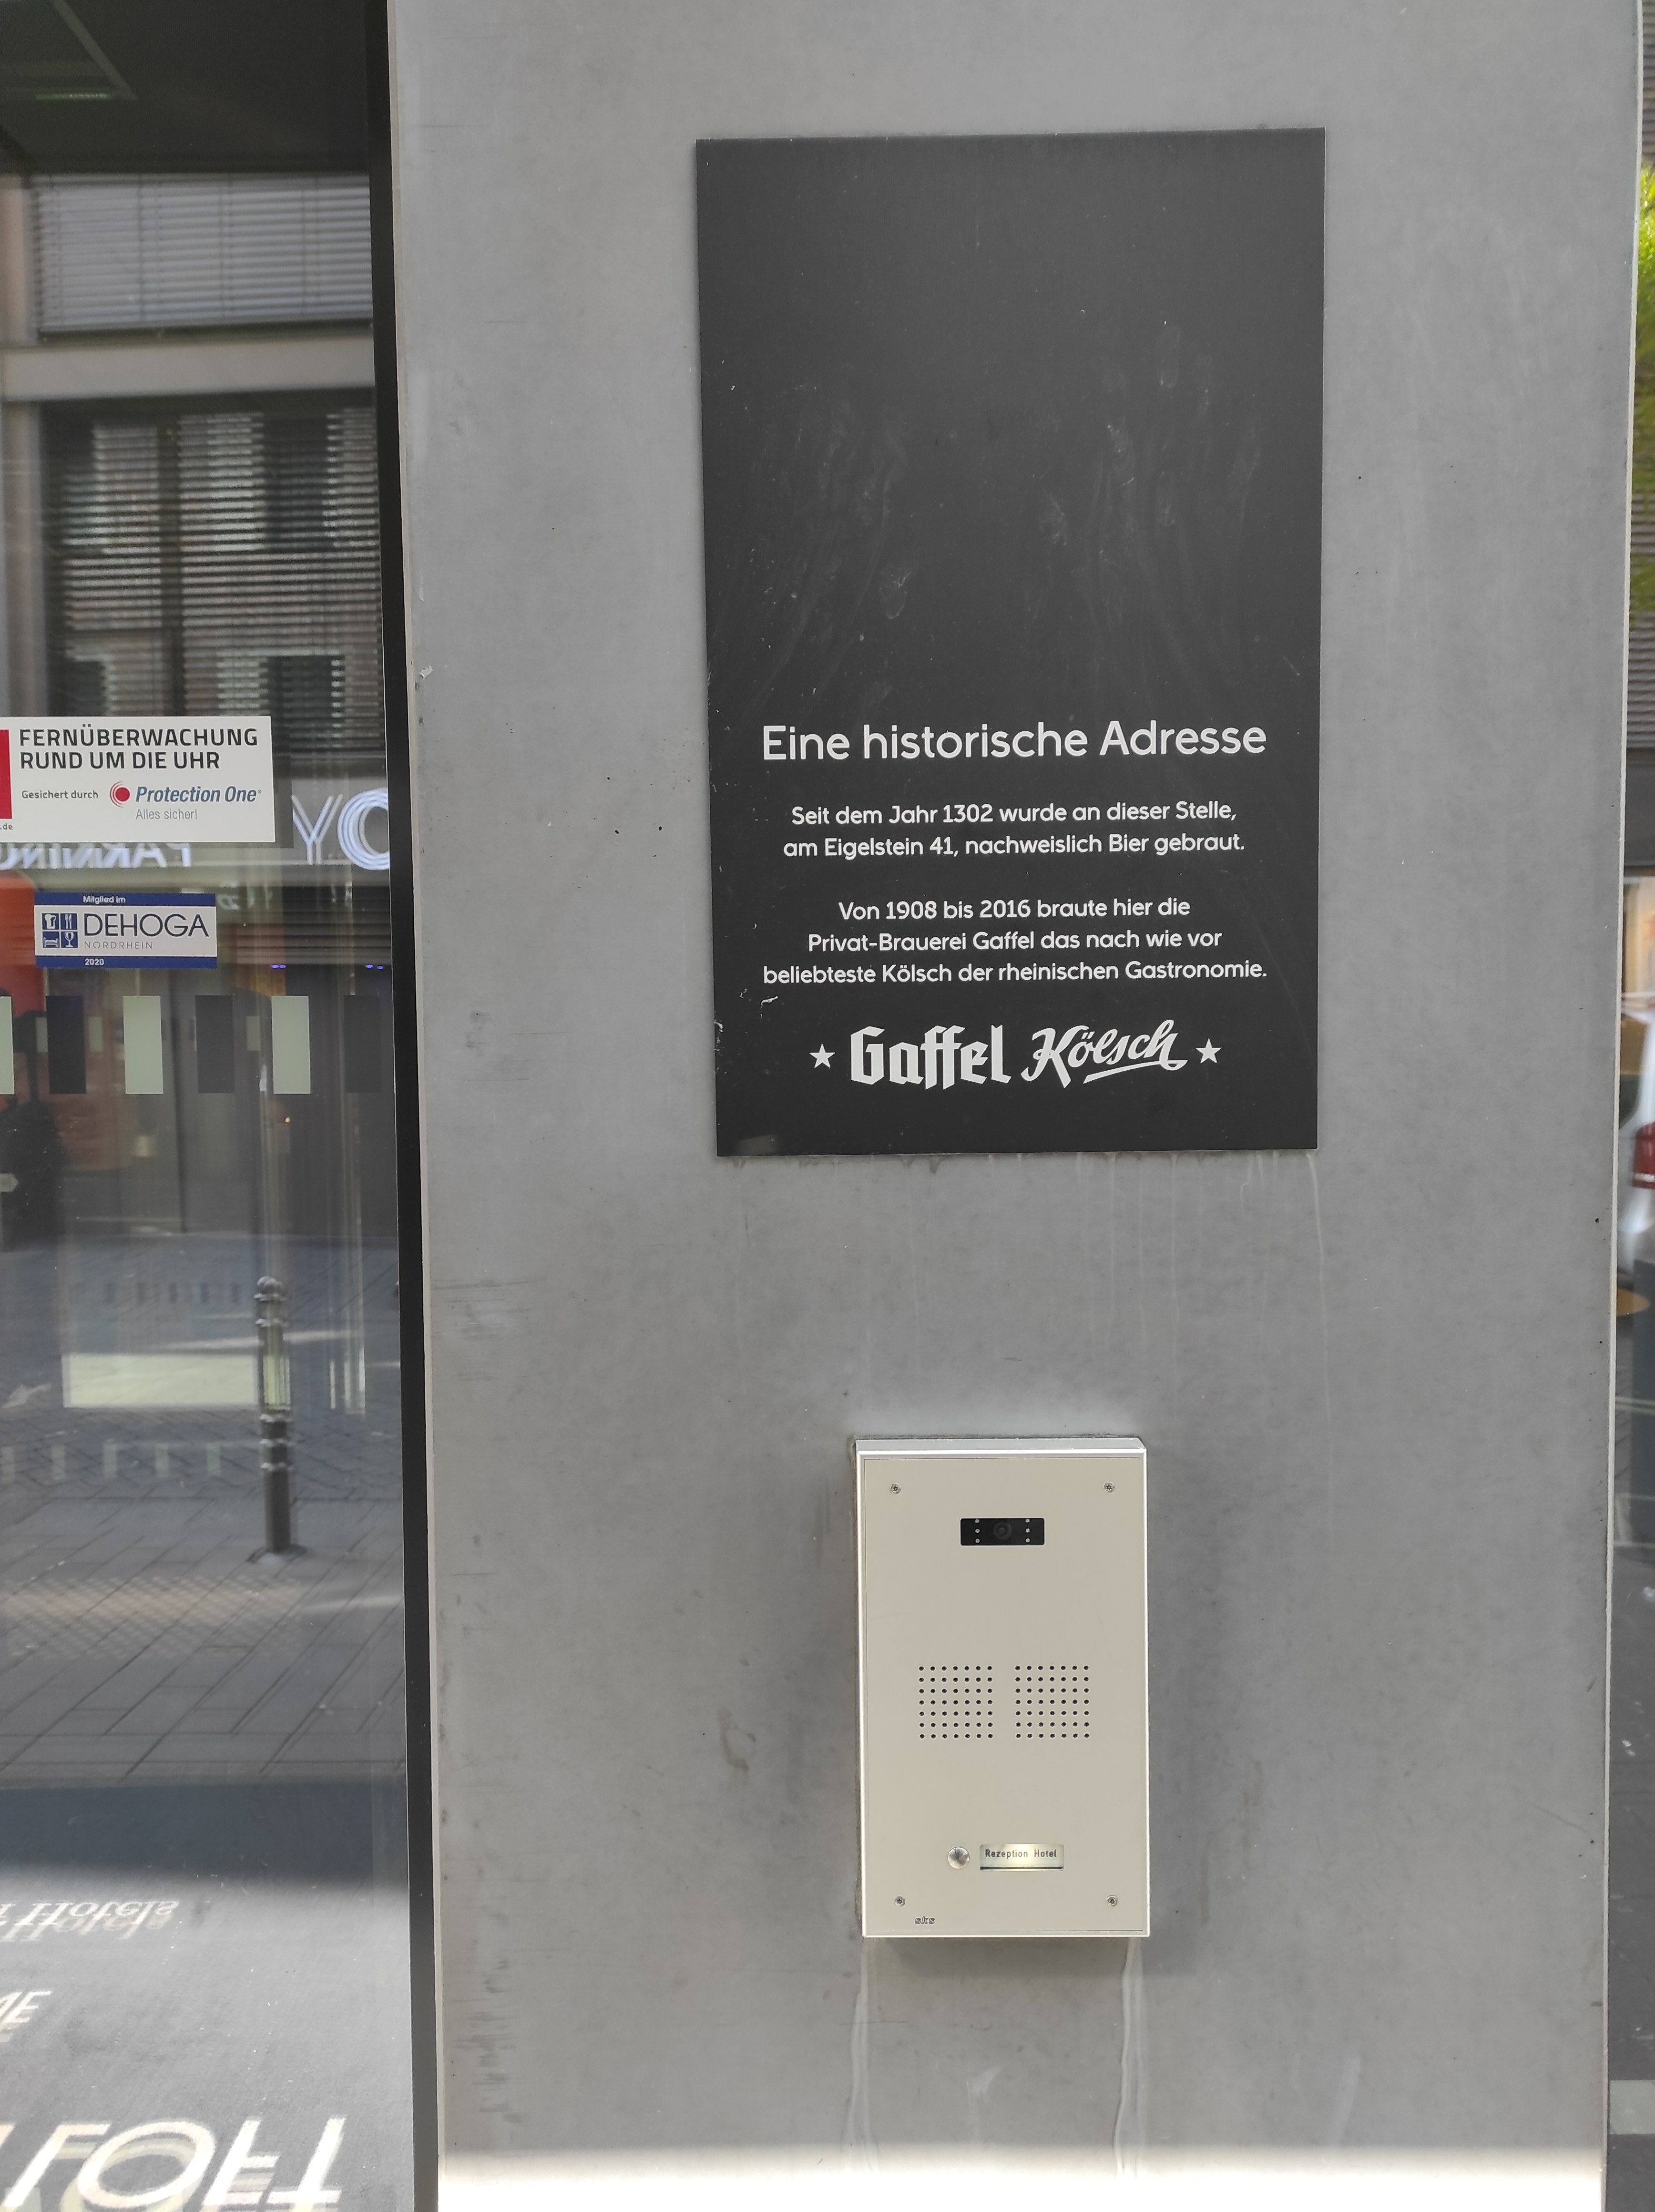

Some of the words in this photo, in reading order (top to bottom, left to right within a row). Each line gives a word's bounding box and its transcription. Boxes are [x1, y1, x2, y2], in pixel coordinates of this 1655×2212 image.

[20, 724, 258, 747] FERNÜBERWACHUNG
[763, 725, 850, 760] Eine
[864, 722, 1088, 759] historische
[1099, 719, 1267, 756] Adresse
[20, 752, 82, 769] RUND
[90, 752, 124, 769] UM
[133, 752, 167, 769] DIE
[174, 751, 219, 769] UHR
[21, 790, 68, 799] Gesichert
[71, 790, 99, 799] durch
[135, 786, 221, 802] Protection
[135, 809, 160, 819] Alles
[163, 809, 197, 819] sicher!
[792, 806, 830, 825] Seit
[835, 806, 882, 824] dem
[888, 805, 938, 824] Jahr
[943, 804, 993, 823] 1302
[999, 803, 1067, 822] wurde
[1072, 807, 1100, 821] an
[1106, 802, 1171, 820] dieser
[1175, 800, 1236, 821] Stelle,
[783, 842, 817, 857] am
[825, 837, 923, 860] Eigelstein
[930, 836, 959, 857] 41,
[966, 834, 1102, 854] nachweislich
[1109, 834, 1149, 852] Bier
[1154, 833, 1245, 856] gebraut.
[83, 895, 114, 905] Mitglied
[116, 895, 126, 903] im
[838, 901, 880, 920] Von
[886, 901, 937, 920] 1908
[944, 901, 974, 919] bis
[979, 899, 1031, 918] 2016
[1037, 899, 1108, 918] braute
[1114, 898, 1153, 916] hier
[1157, 897, 1191, 916] die
[83, 913, 209, 937] DEHOGA
[84, 941, 153, 950] NORDRHEIN
[808, 932, 966, 952] Privat-Brauerei
[972, 931, 1034, 950] Gaffel
[1041, 931, 1080, 949] das
[1086, 929, 1140, 948] nach
[1145, 929, 1182, 947] wie
[1187, 932, 1223, 947] vor
[764, 965, 876, 984] beliebteste
[882, 963, 952, 983] Kölsch
[958, 963, 993, 982] der
[999, 962, 1119, 981] rheinischen
[1125, 960, 1267, 979] Gastronomie.
[850, 1024, 1012, 1090] Gaffel
[1021, 1019, 1189, 1088] Kölsch
[985, 1849, 1028, 1859] Rezeption
[1034, 1849, 1057, 1858] Hotel
